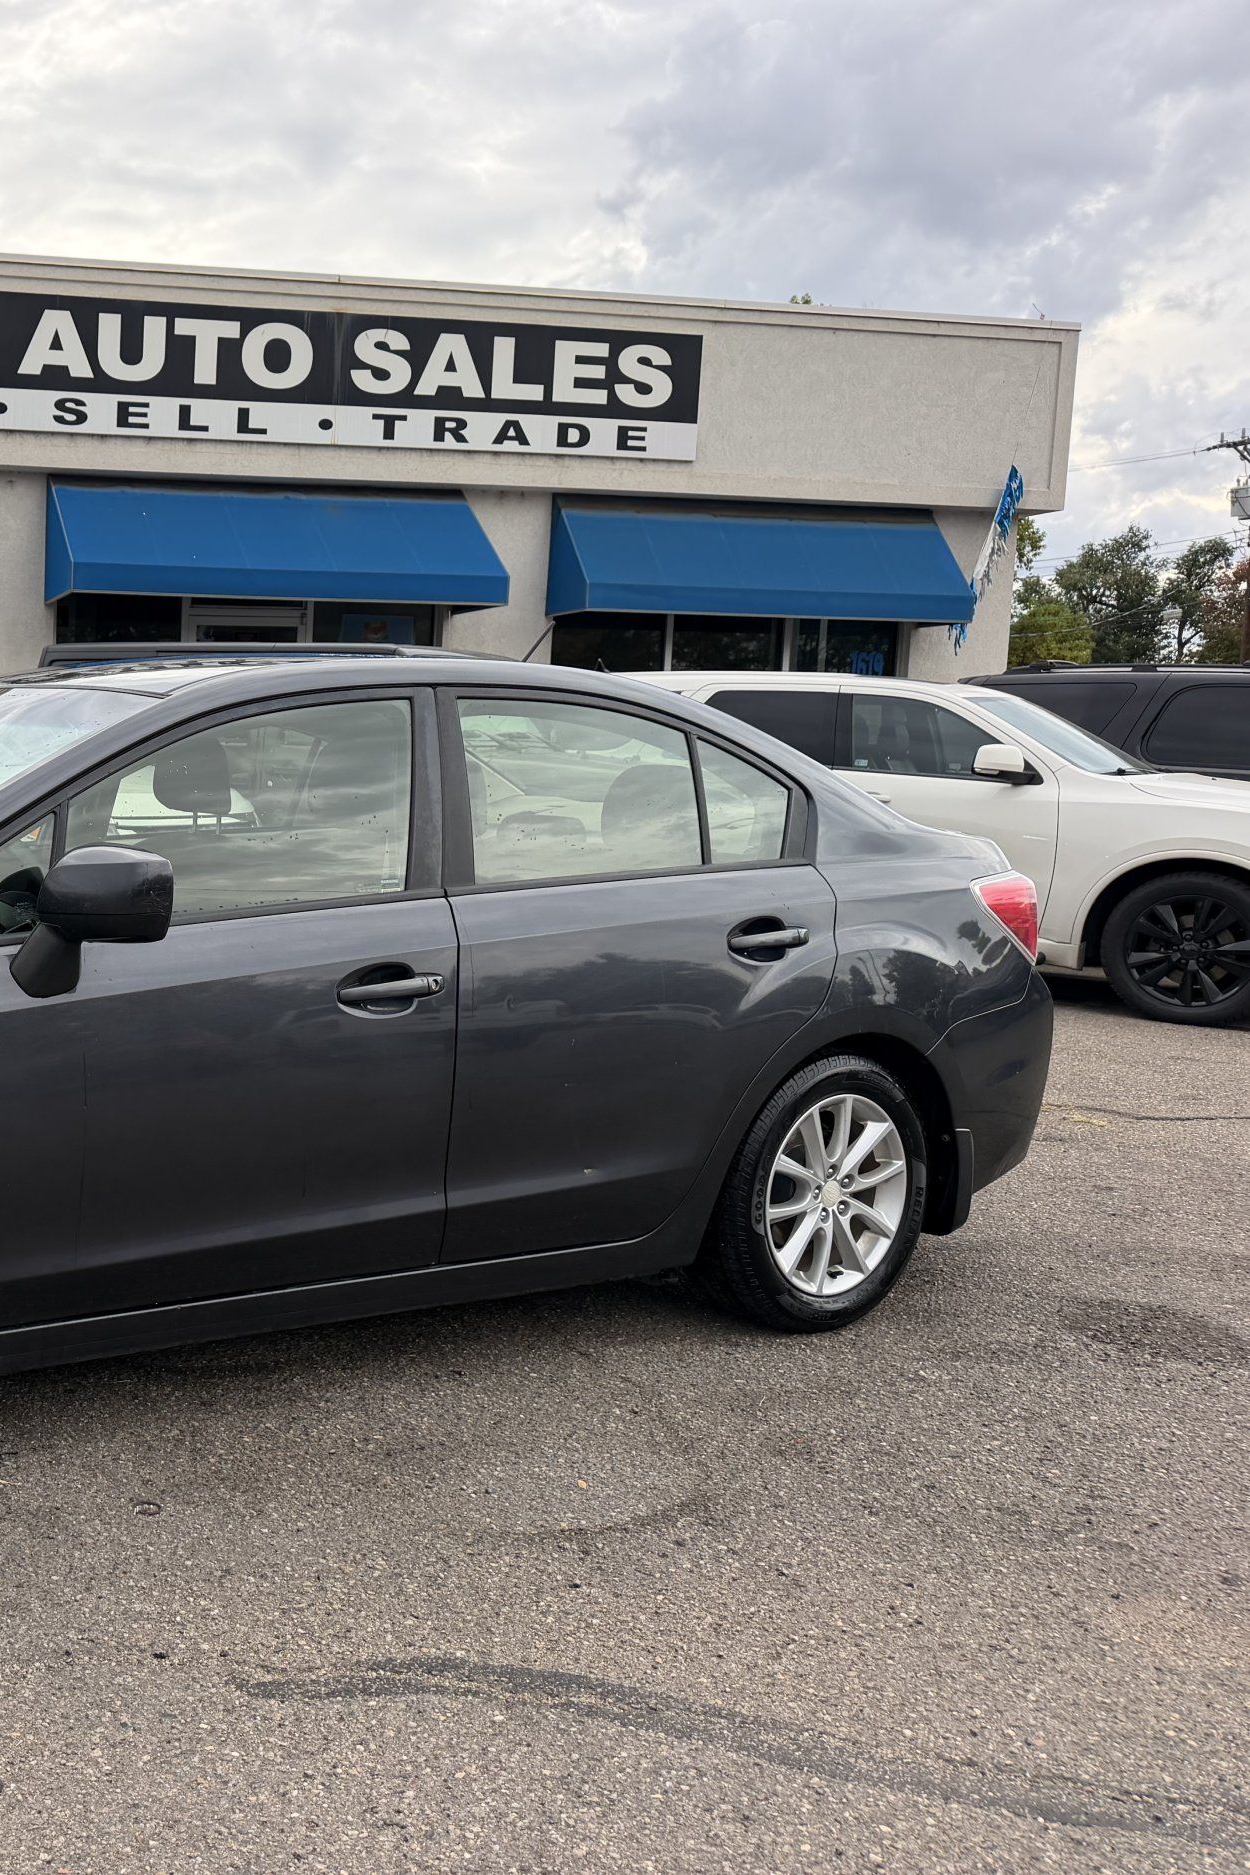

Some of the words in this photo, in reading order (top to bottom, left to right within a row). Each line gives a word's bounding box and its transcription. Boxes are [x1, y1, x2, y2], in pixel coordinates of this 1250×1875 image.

[16, 309, 314, 390] AUTO
[350, 328, 674, 408] SALES
[52, 398, 268, 436] SELL
[371, 413, 648, 452] TRADE
